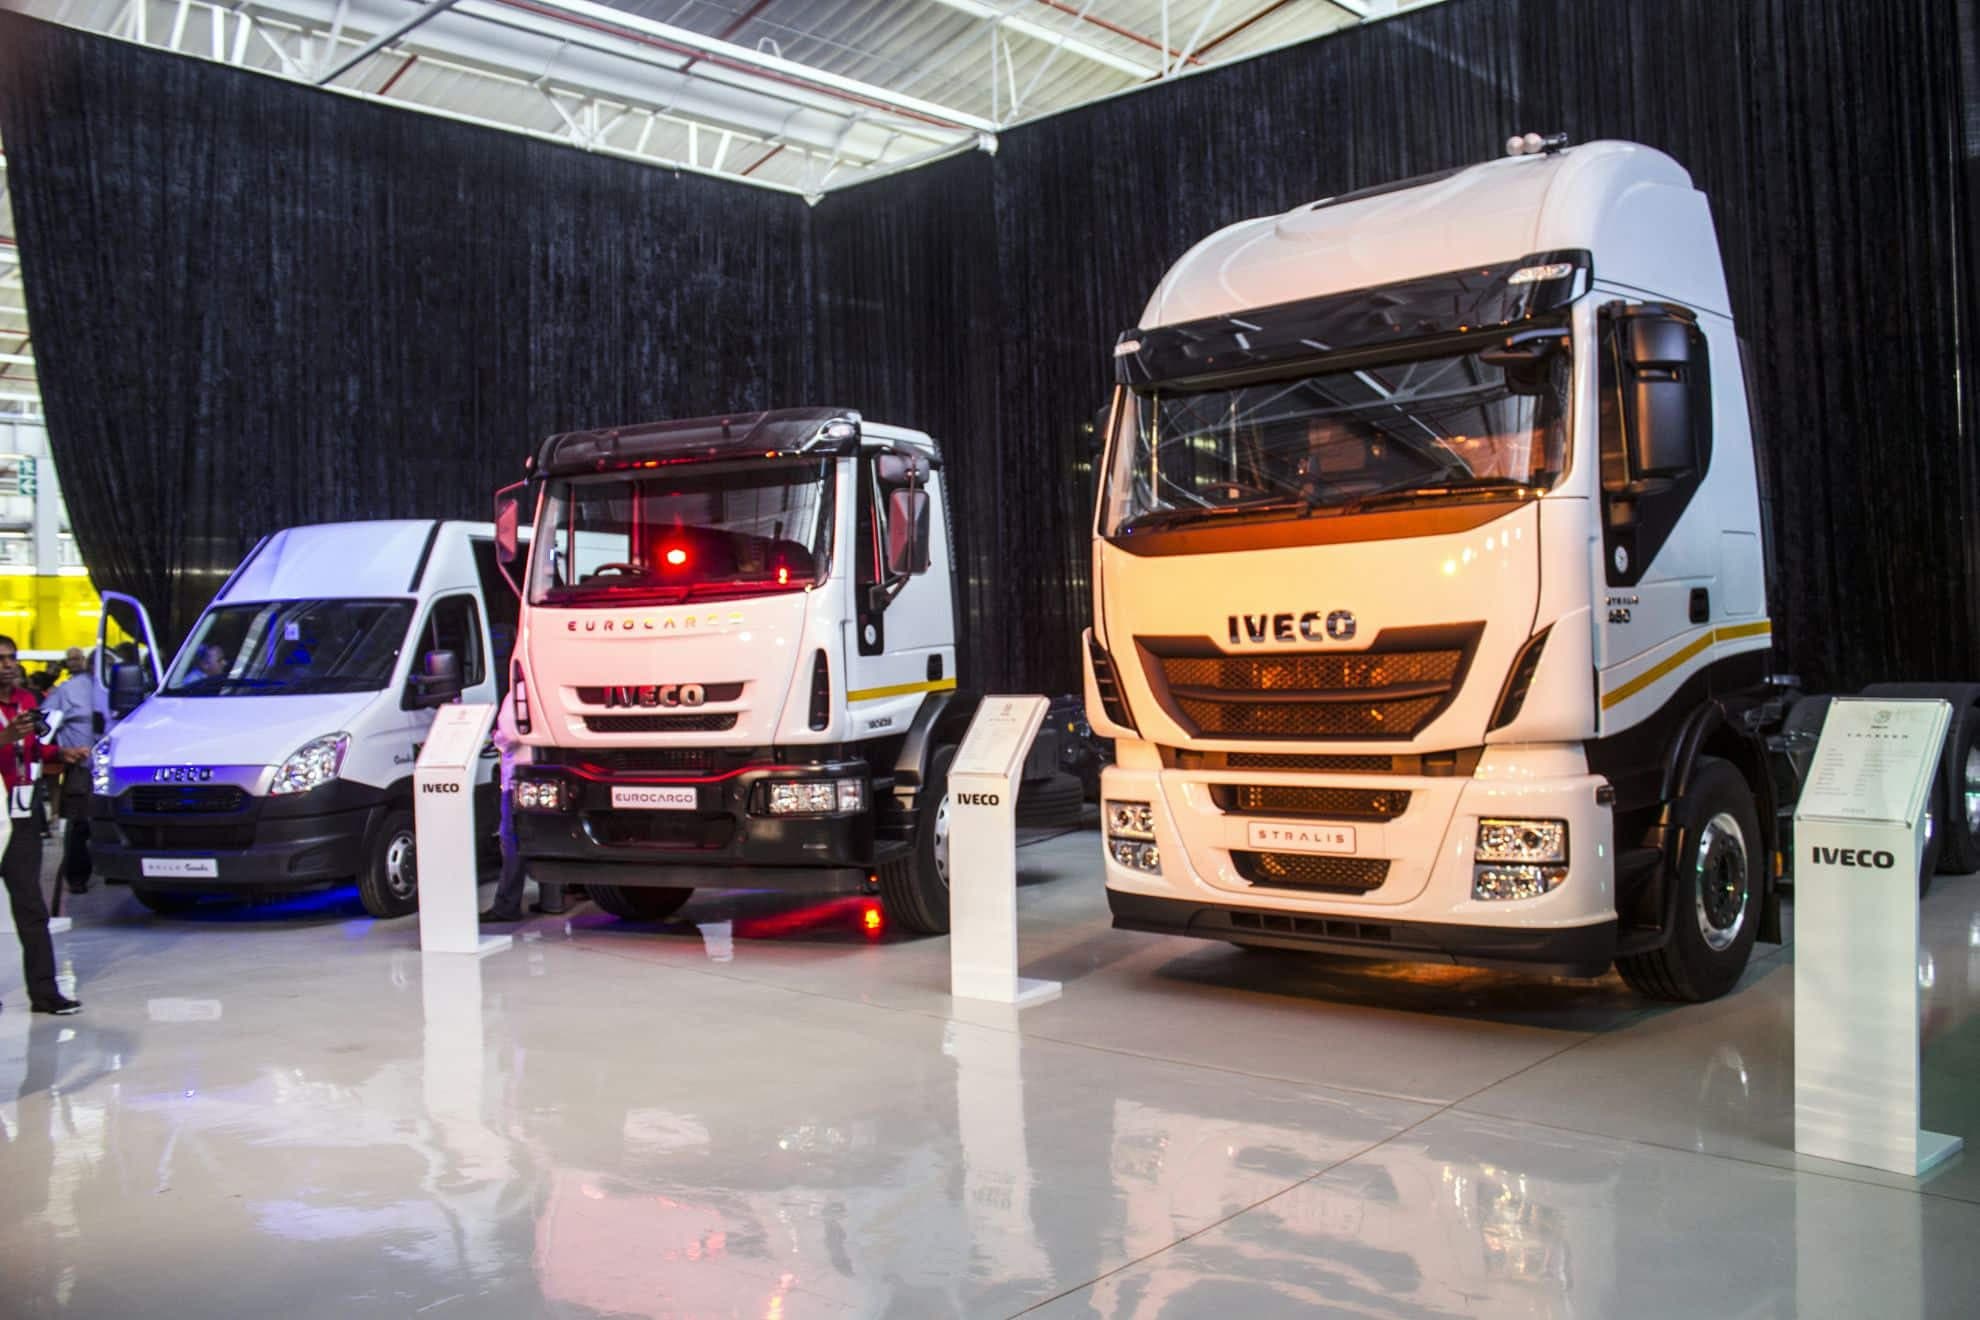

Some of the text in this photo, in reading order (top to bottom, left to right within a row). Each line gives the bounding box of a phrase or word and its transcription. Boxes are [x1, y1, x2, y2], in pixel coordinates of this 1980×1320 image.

[1228, 609, 1357, 645] IVECO
[604, 683, 704, 709] IVECO
[422, 783, 460, 793] IVECO
[615, 793, 694, 803] EUROCARGO
[957, 793, 1000, 806] IVECO
[1258, 829, 1345, 844] STRALIS
[1812, 846, 1895, 869] IVECO
